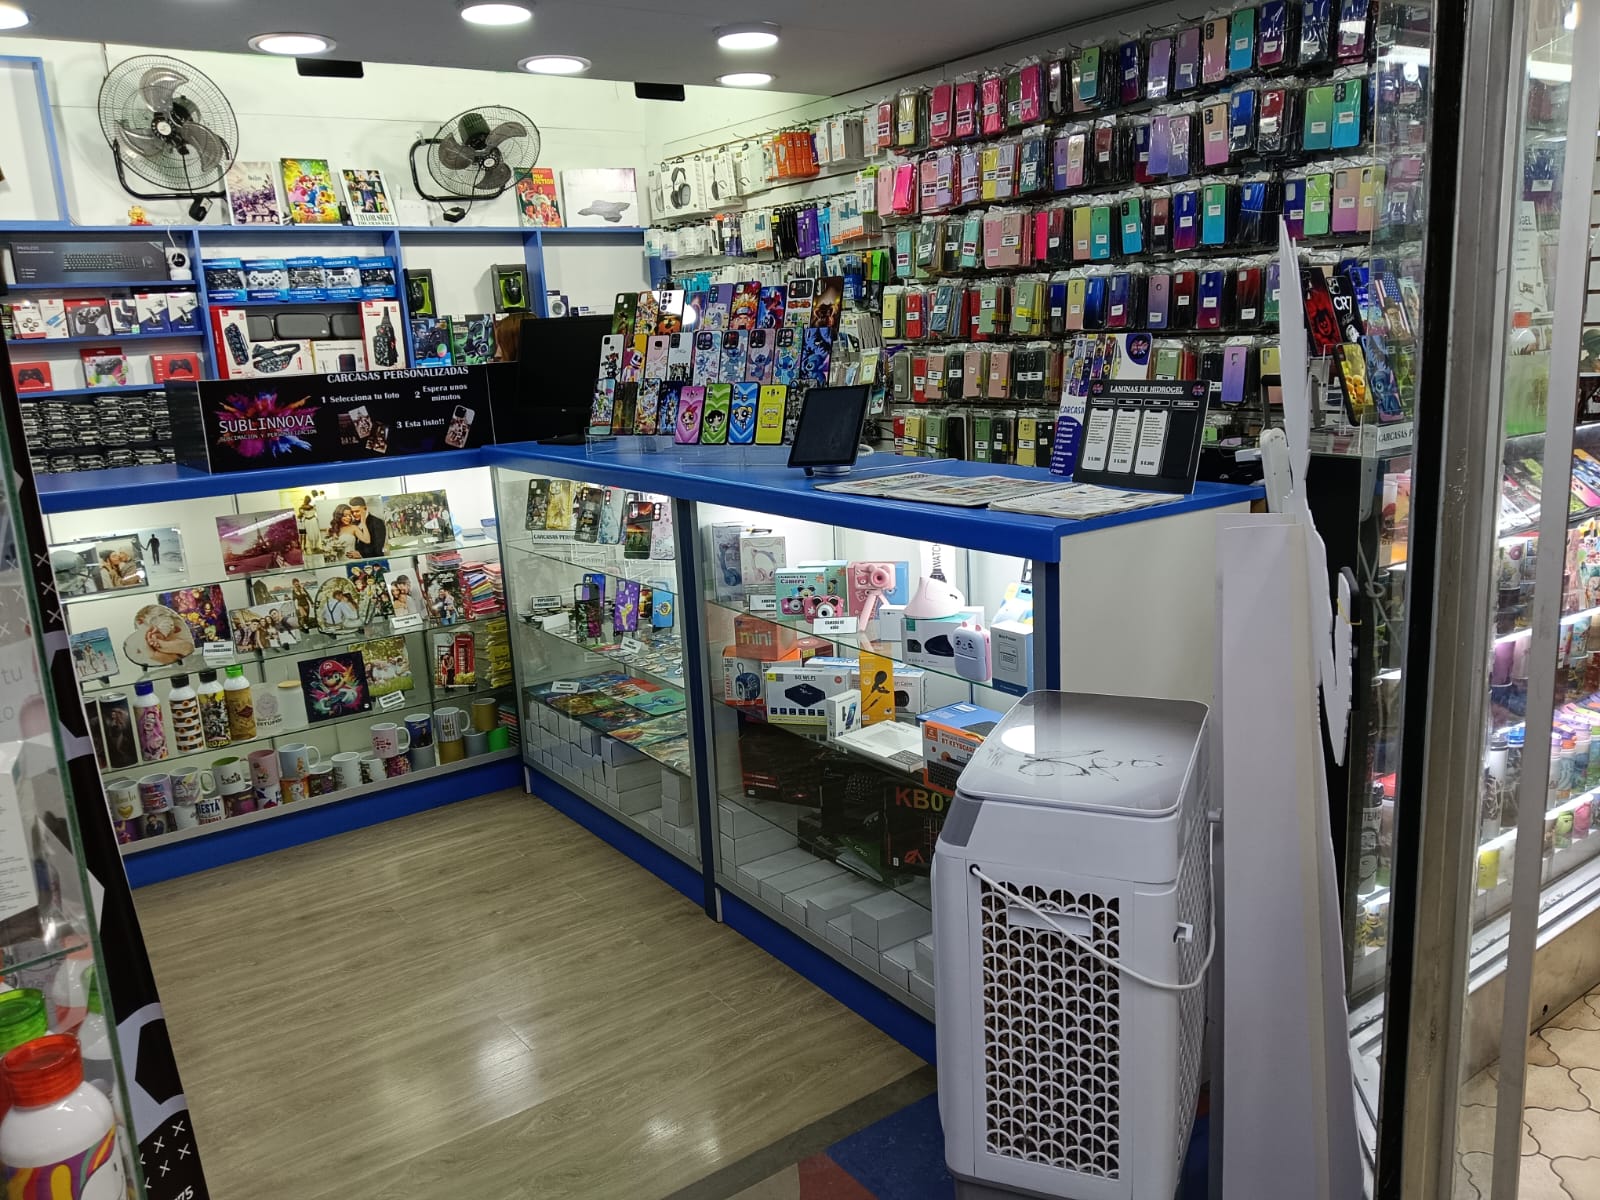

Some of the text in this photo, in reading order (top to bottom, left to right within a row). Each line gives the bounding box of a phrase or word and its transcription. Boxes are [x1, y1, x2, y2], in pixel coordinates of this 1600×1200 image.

[1333, 295, 1352, 315] CR7
[327, 365, 469, 384] CARCASAS PERSONALIZADAS
[329, 392, 373, 404] Selecciona
[373, 393, 383, 401] tu
[384, 391, 400, 400] foto
[414, 383, 468, 399] 2 Espera unos
[431, 393, 462, 402] minutos
[1109, 385, 1185, 395] LAMINAS DE HIDROGEL
[218, 413, 316, 434] SUBLINNOVA
[396, 420, 403, 429] 3
[404, 419, 422, 428] Esta
[895, 785, 951, 812] KB0
